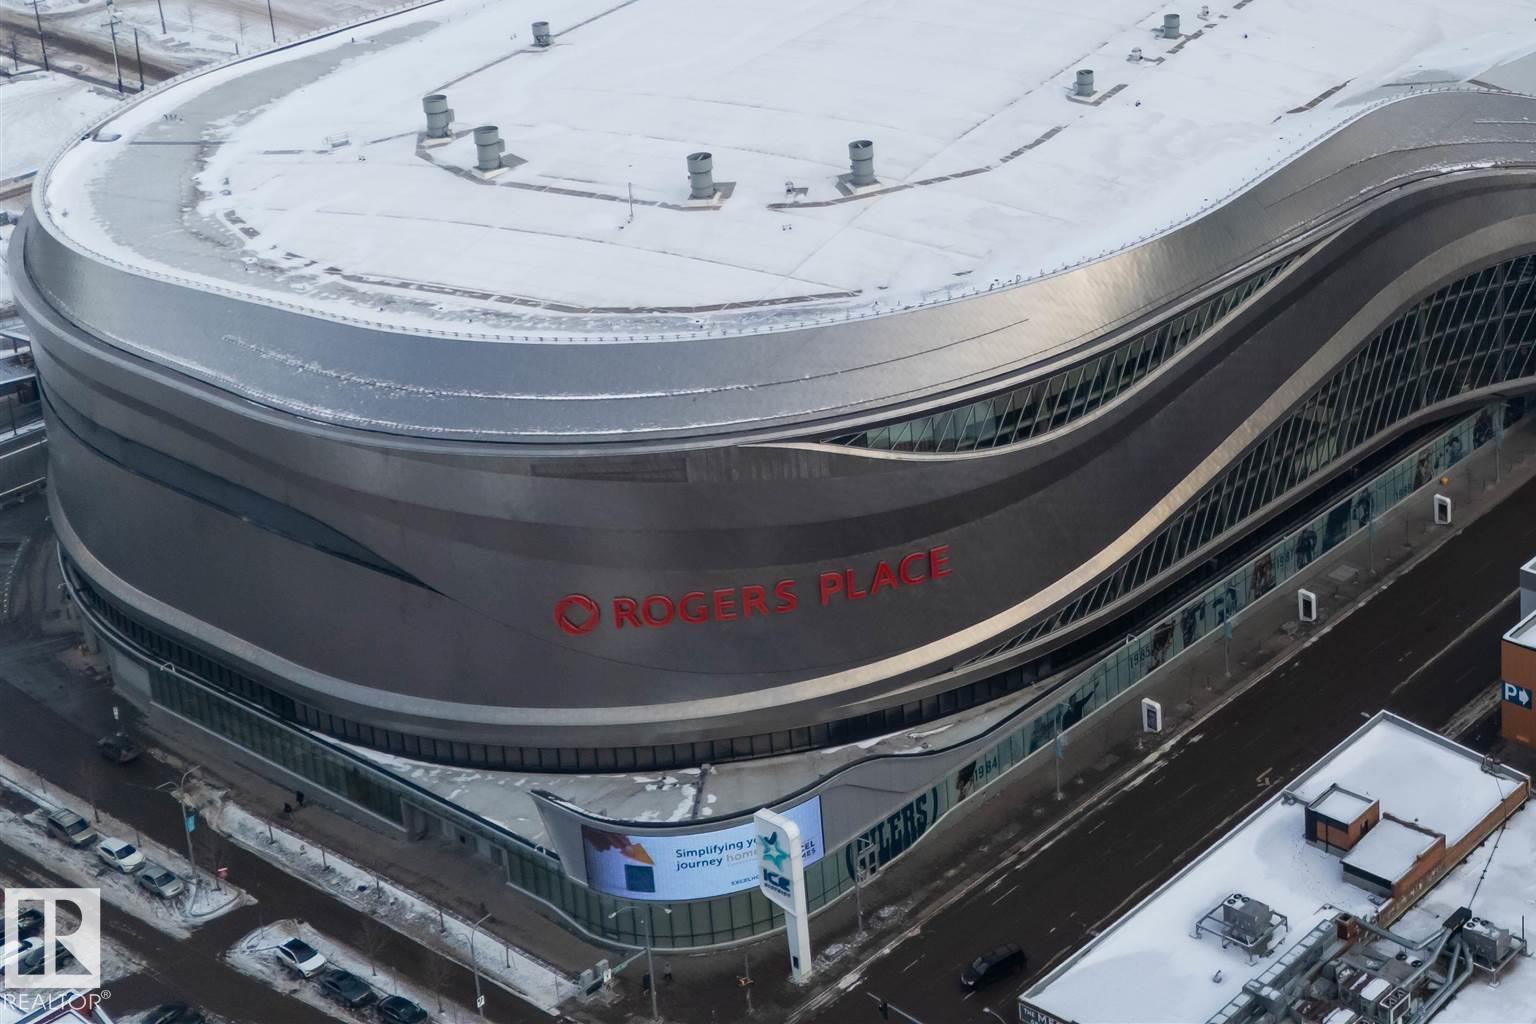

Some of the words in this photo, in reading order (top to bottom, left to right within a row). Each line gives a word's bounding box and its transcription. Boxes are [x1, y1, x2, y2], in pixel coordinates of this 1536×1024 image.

[612, 579, 798, 629] ROGERS
[820, 544, 952, 607] PLACE
[1504, 682, 1517, 700] P
[975, 756, 998, 781] 1984
[675, 841, 744, 858] Simplifying
[676, 857, 723, 871] journey
